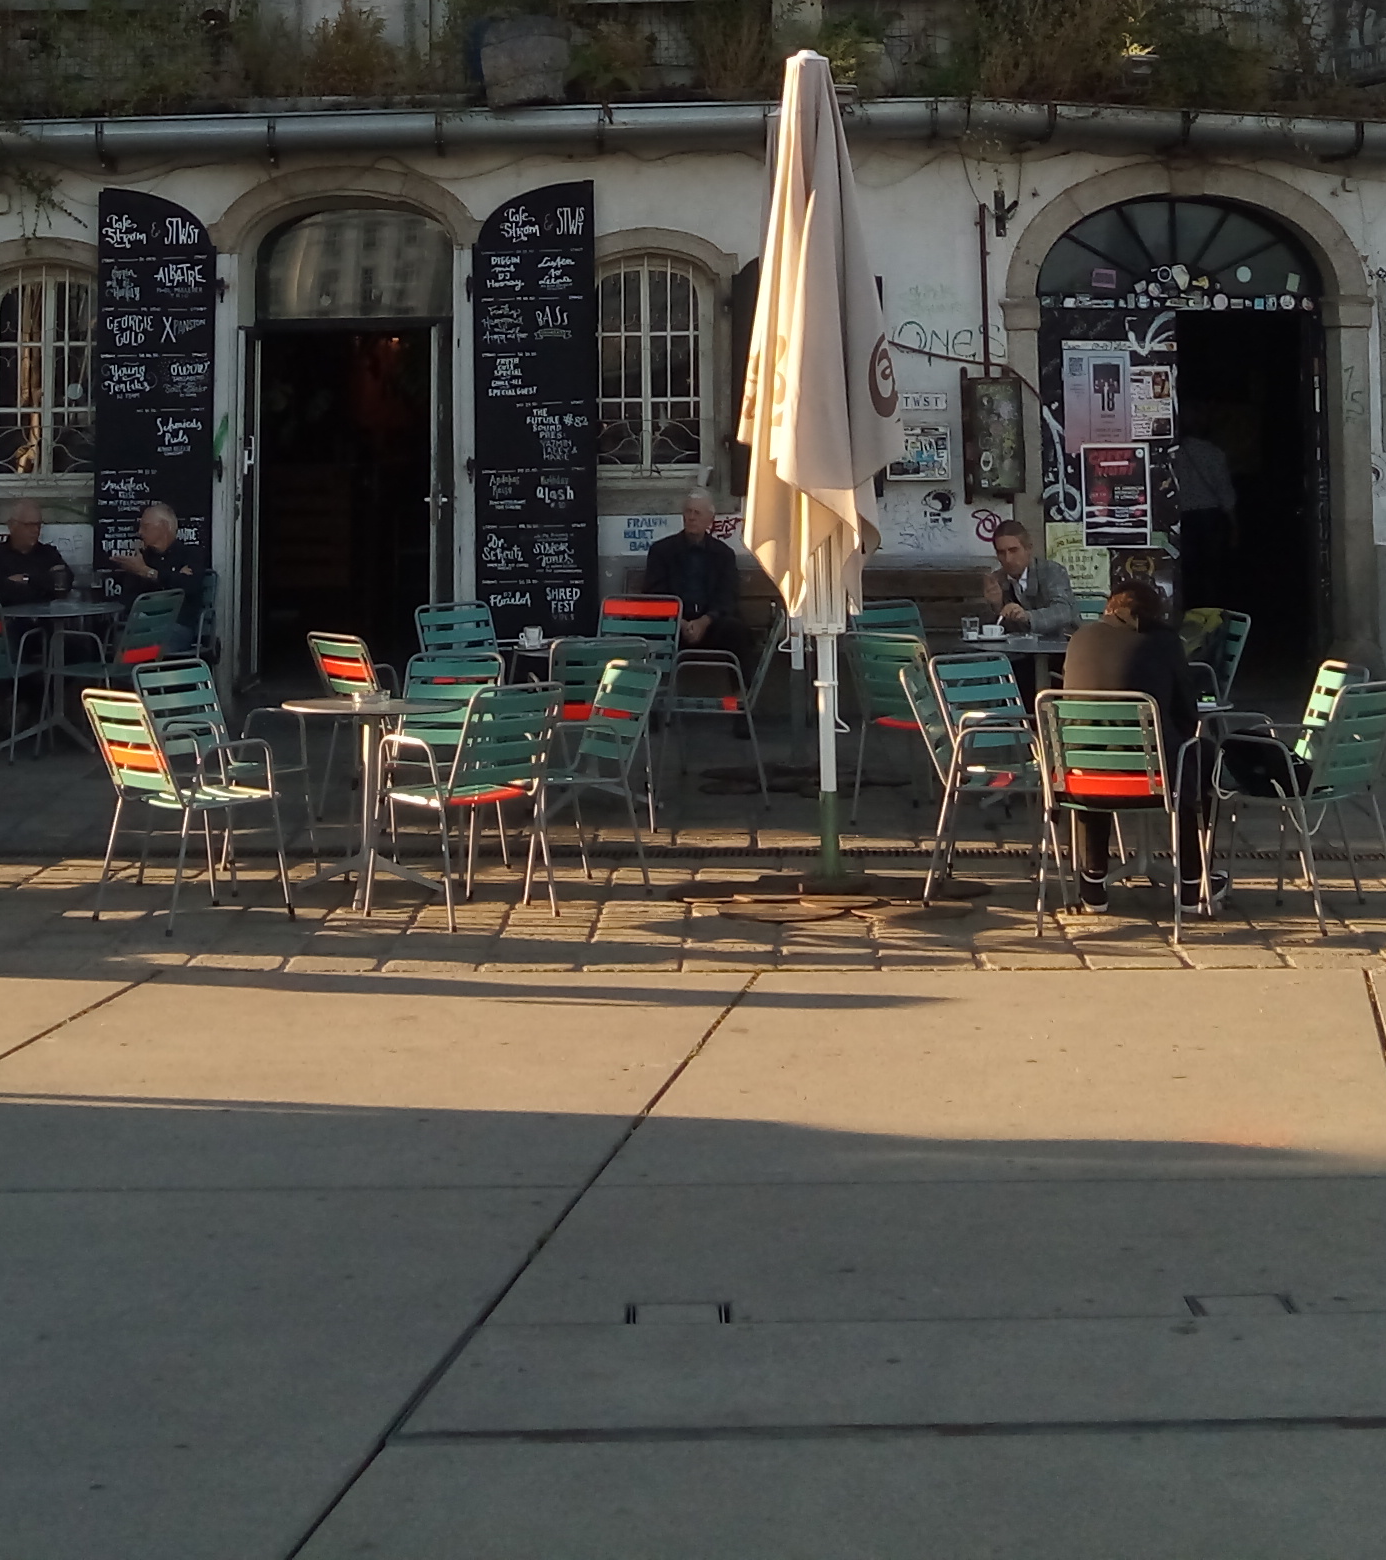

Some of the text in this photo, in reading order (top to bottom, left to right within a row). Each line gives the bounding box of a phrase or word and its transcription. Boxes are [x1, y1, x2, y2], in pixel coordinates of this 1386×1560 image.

[902, 395, 941, 408] TWST
[533, 408, 547, 416] THE
[546, 587, 581, 601] SHRED
[551, 601, 574, 613] FEST
